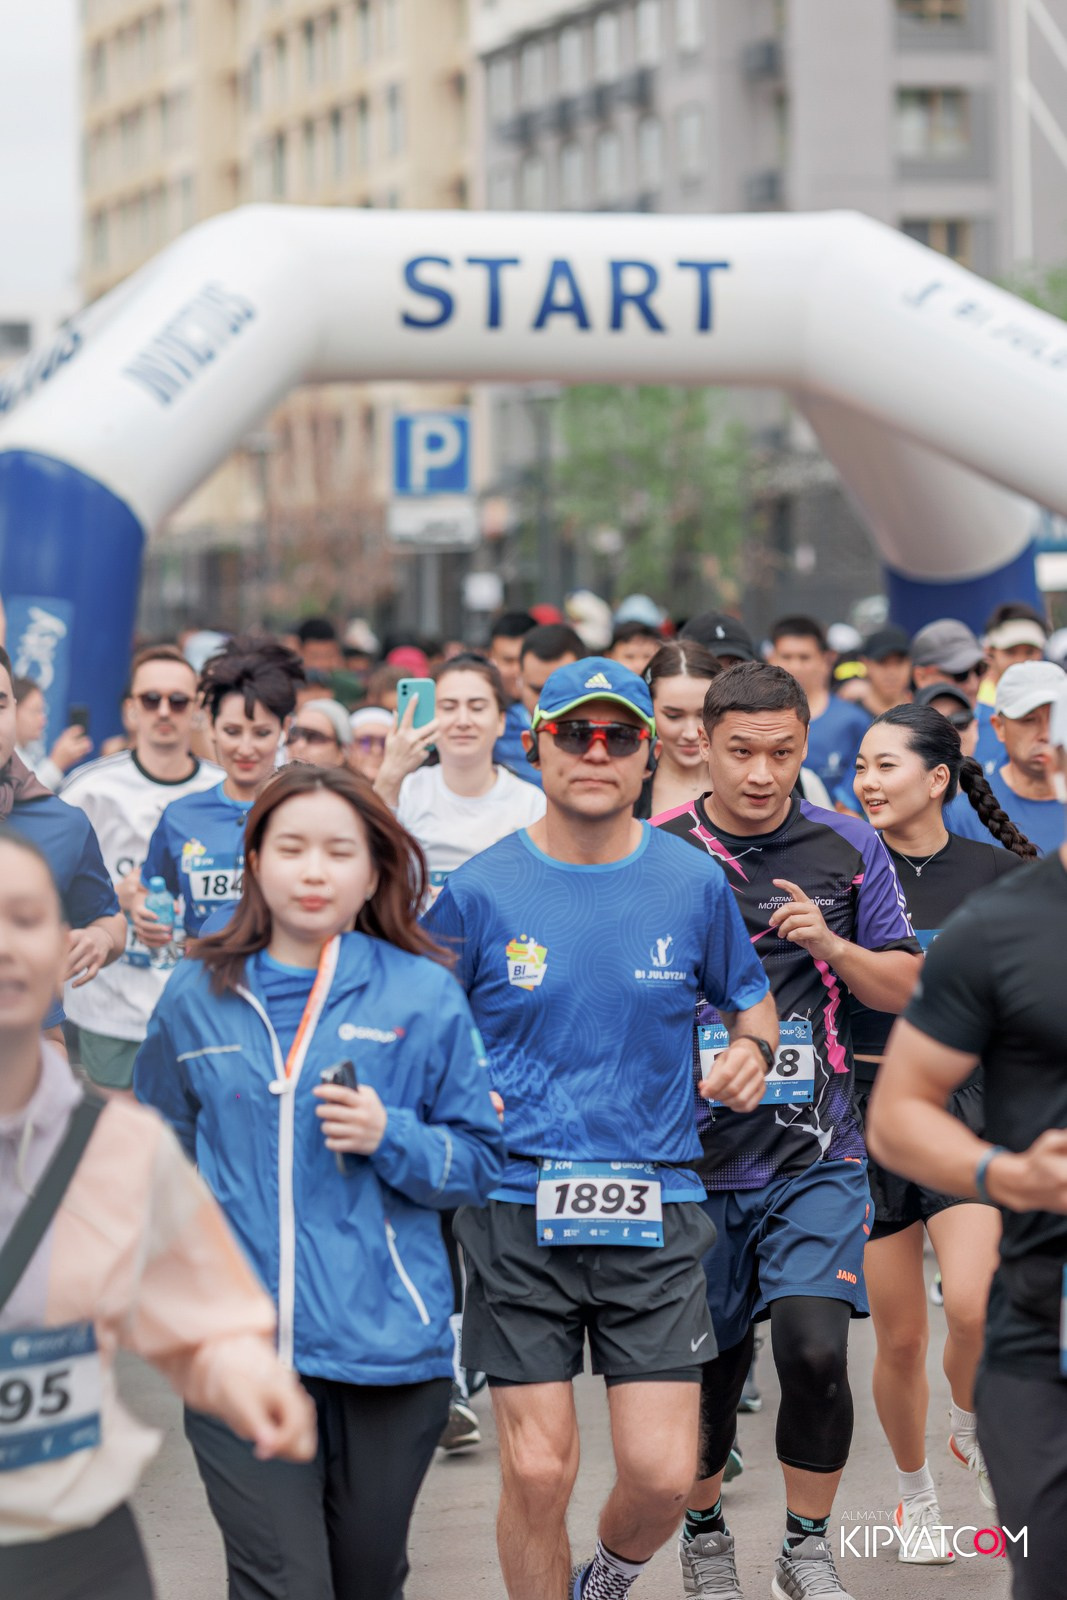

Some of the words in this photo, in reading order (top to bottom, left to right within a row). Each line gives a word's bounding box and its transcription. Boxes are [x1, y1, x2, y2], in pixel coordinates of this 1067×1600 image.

[400, 255, 733, 332] START
[410, 416, 461, 490] P
[513, 965, 526, 976] BI
[703, 1030, 711, 1041] 5
[713, 1030, 728, 1040] KM
[543, 1159, 552, 1171] 5
[554, 1161, 573, 1171] KM
[555, 1183, 650, 1216] 1893
[836, 1269, 857, 1285] JAKO
